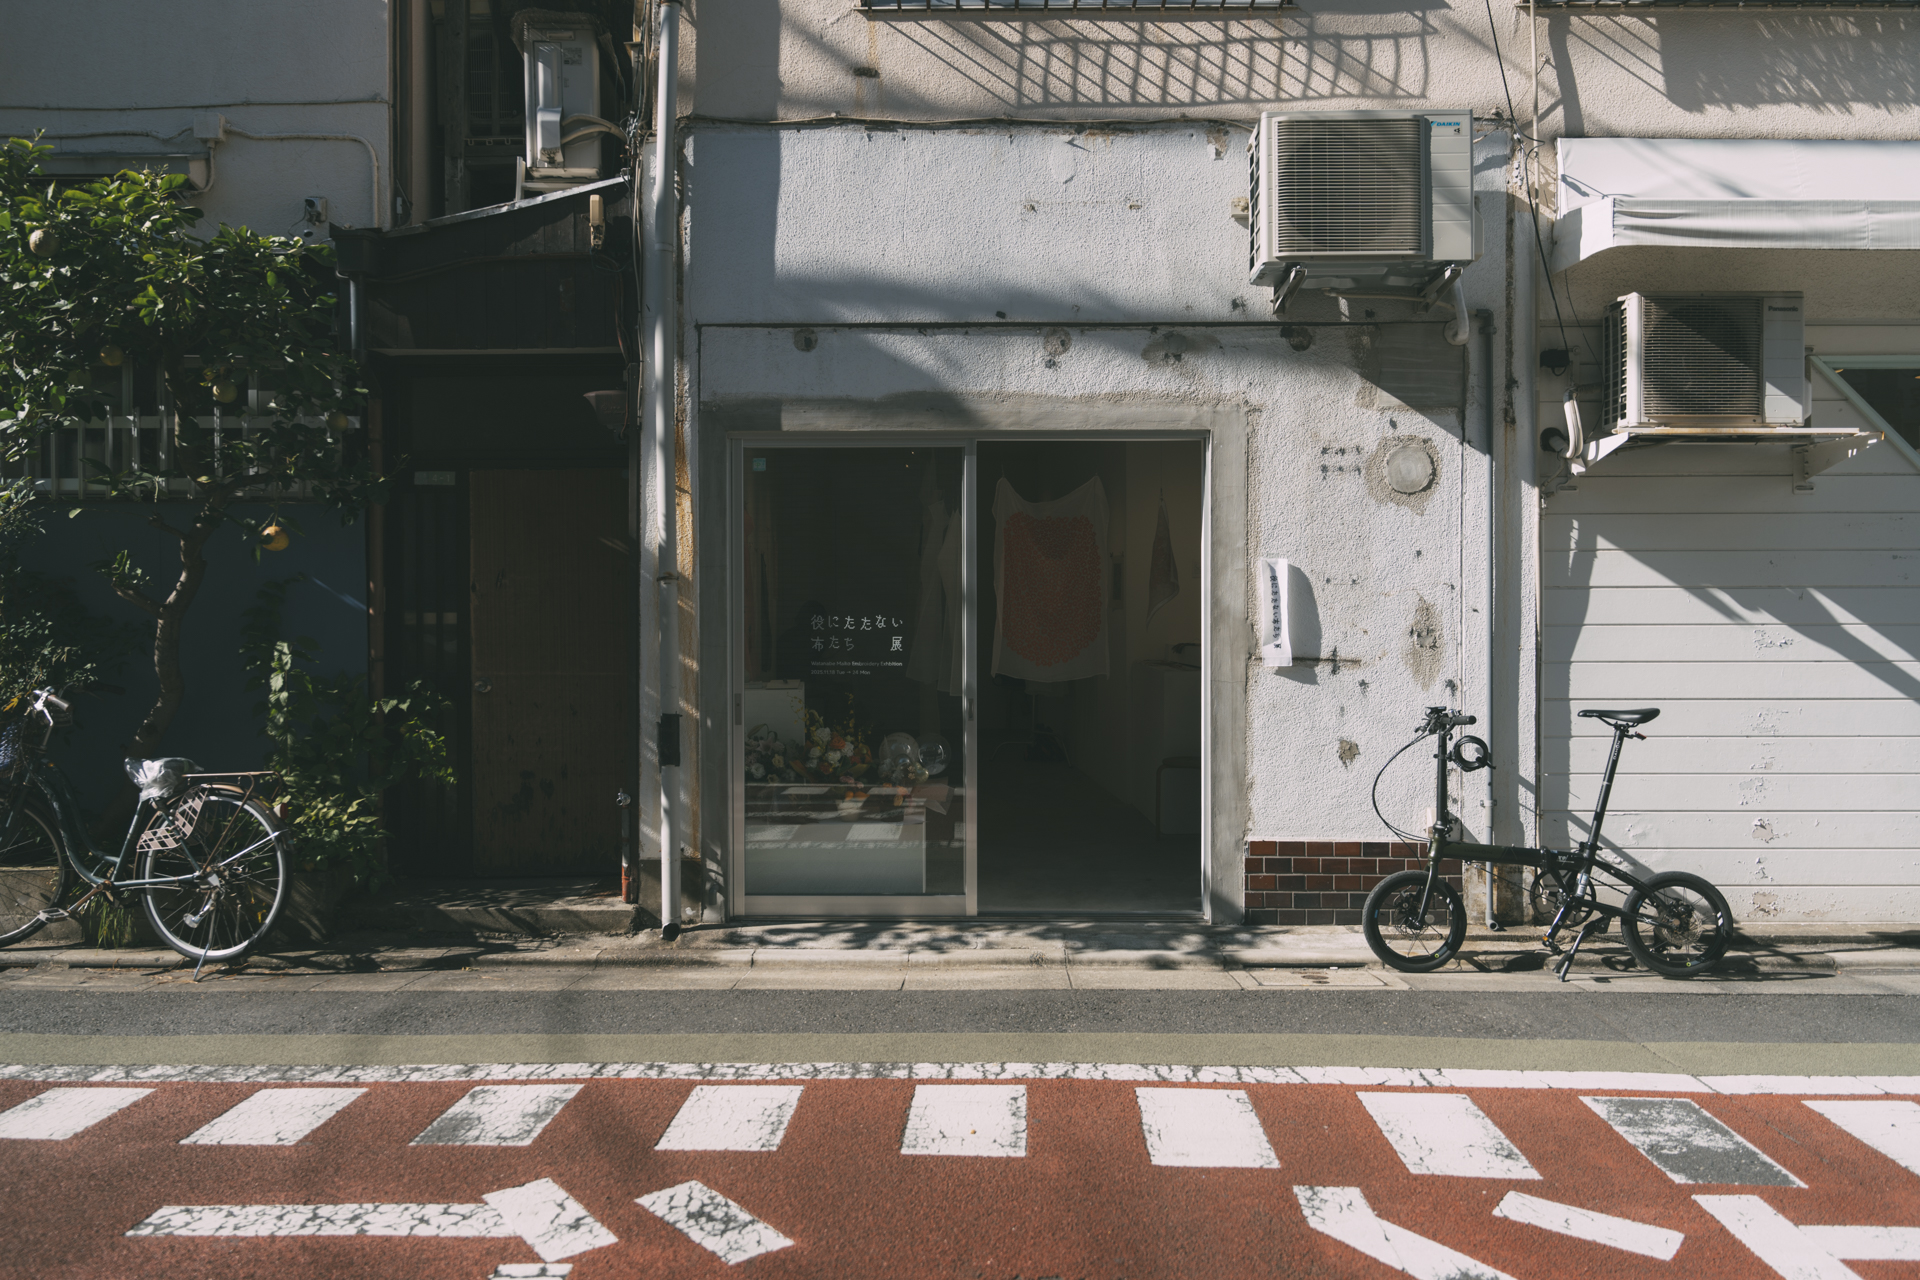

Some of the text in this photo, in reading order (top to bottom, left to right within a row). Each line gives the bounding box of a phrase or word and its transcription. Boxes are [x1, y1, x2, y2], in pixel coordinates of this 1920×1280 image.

[811, 614, 903, 630] 役にたたない
[811, 636, 903, 652] 布たち 展
